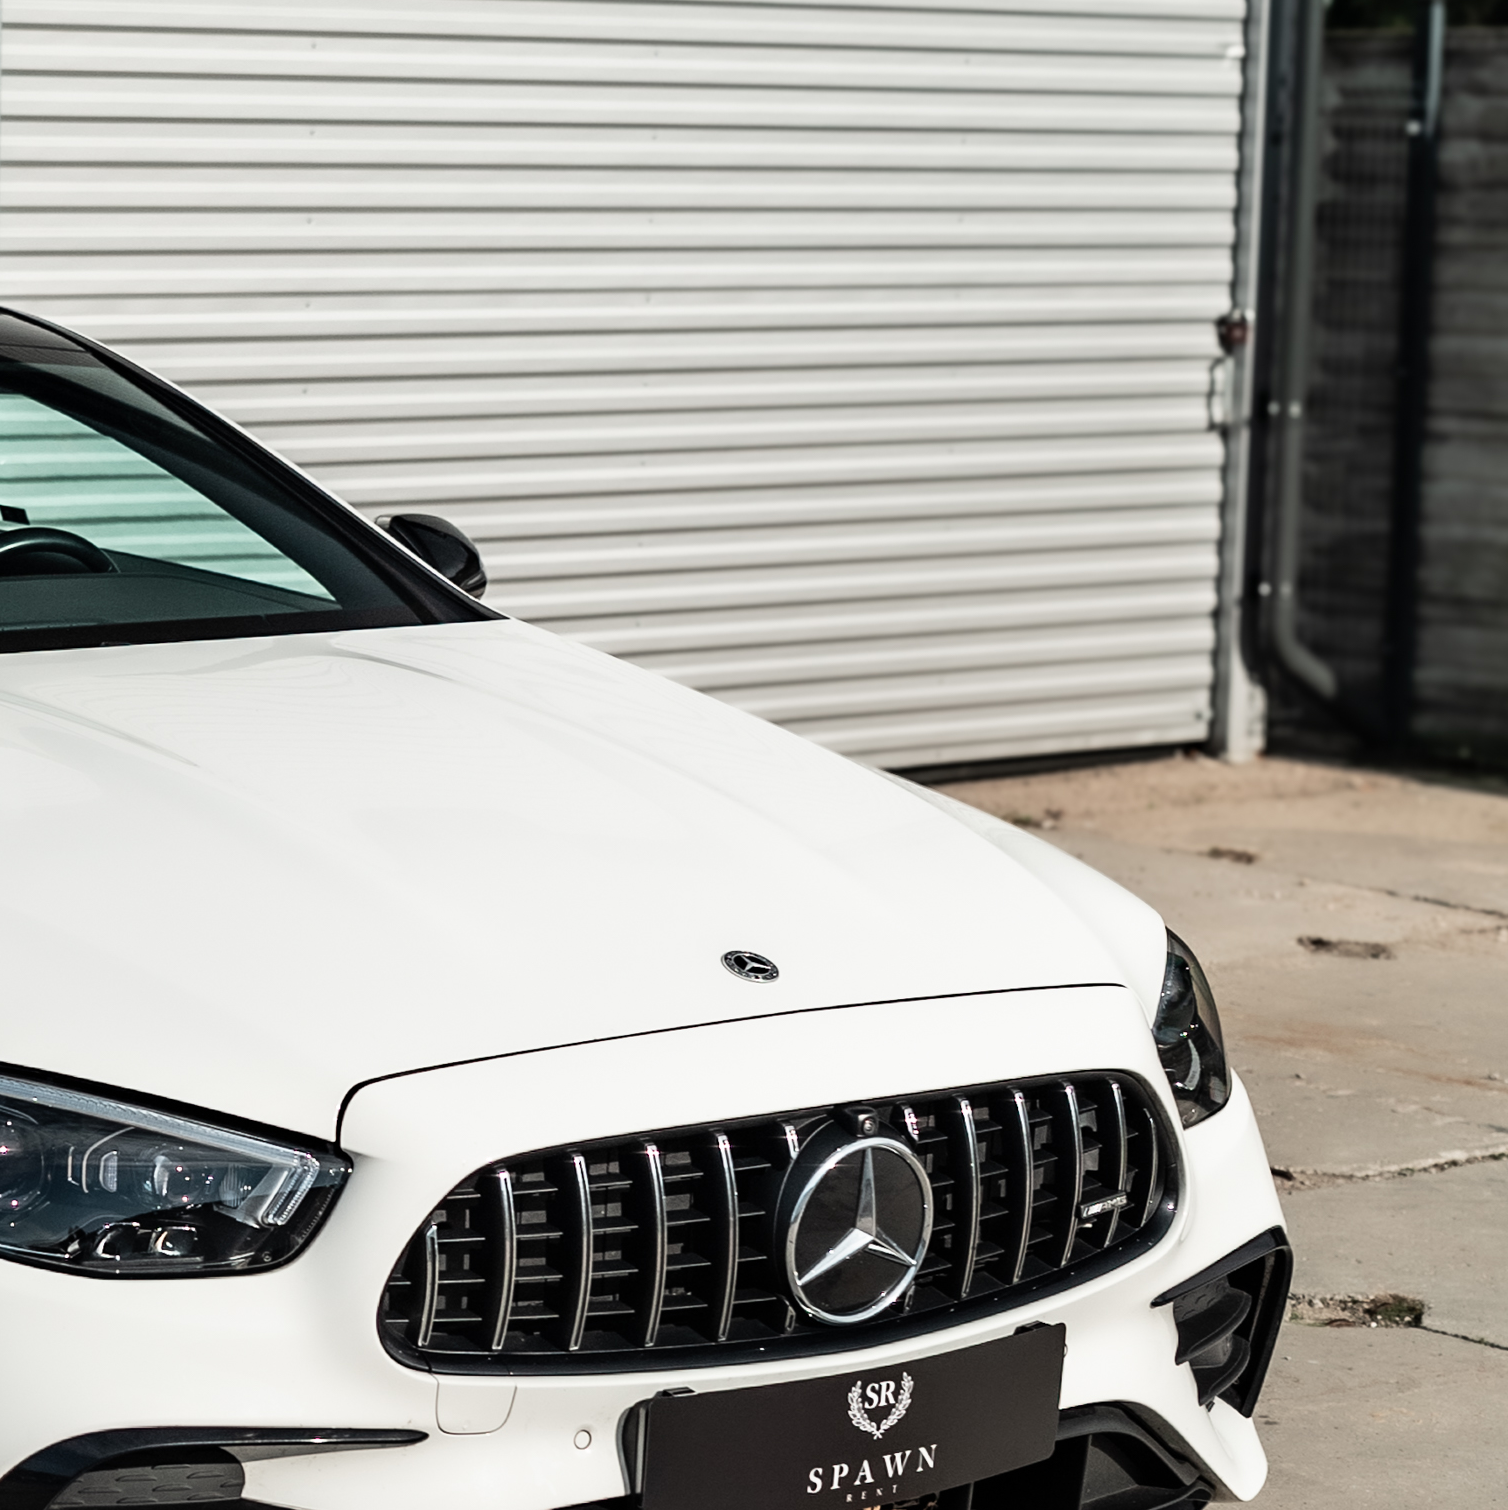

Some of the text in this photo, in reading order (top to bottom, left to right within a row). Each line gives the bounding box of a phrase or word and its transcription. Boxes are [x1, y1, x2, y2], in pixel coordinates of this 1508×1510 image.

[1100, 1195, 1127, 1210] AMG
[864, 1380, 896, 1410] SR
[806, 1444, 938, 1494] SPAWN
[846, 1484, 898, 1503] RENT
